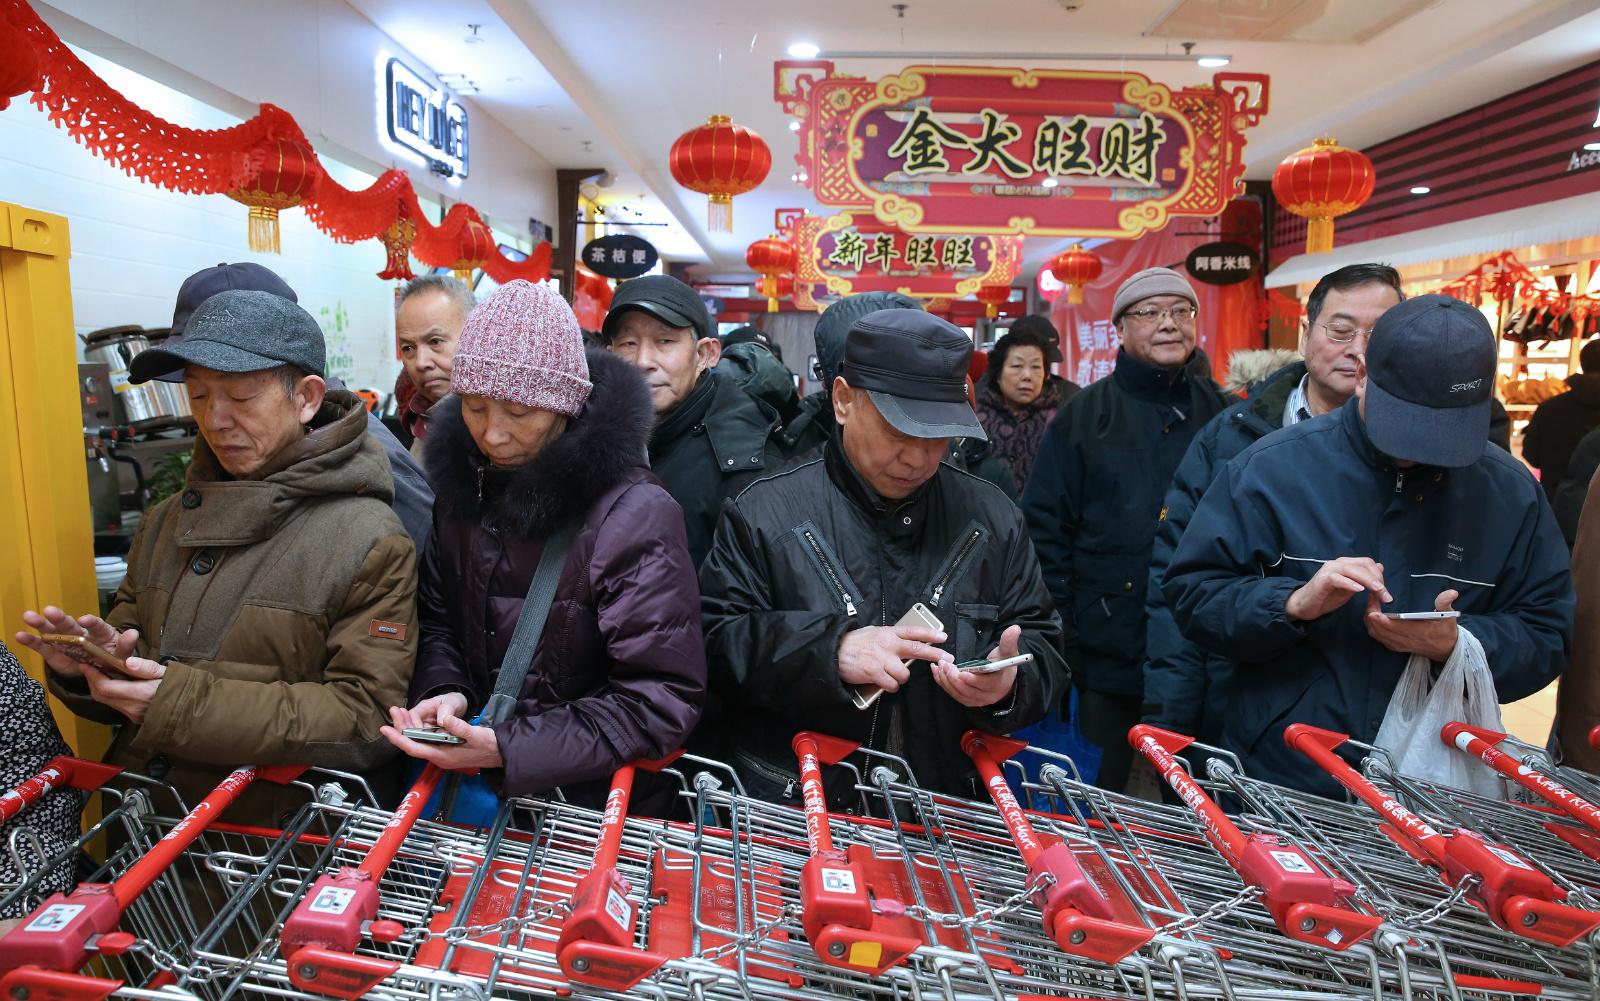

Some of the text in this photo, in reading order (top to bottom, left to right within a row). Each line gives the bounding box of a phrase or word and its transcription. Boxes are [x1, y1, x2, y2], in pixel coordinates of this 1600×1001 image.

[890, 109, 1165, 184] 金犬旺财
[591, 247, 647, 265] 茶桔便
[830, 233, 975, 271] 新年旺旺
[1194, 254, 1251, 272] 阿香米线
[1077, 358, 1117, 388] 敬请
[1449, 378, 1483, 393] SPORT
[1007, 809, 1037, 850] RT-Mart
